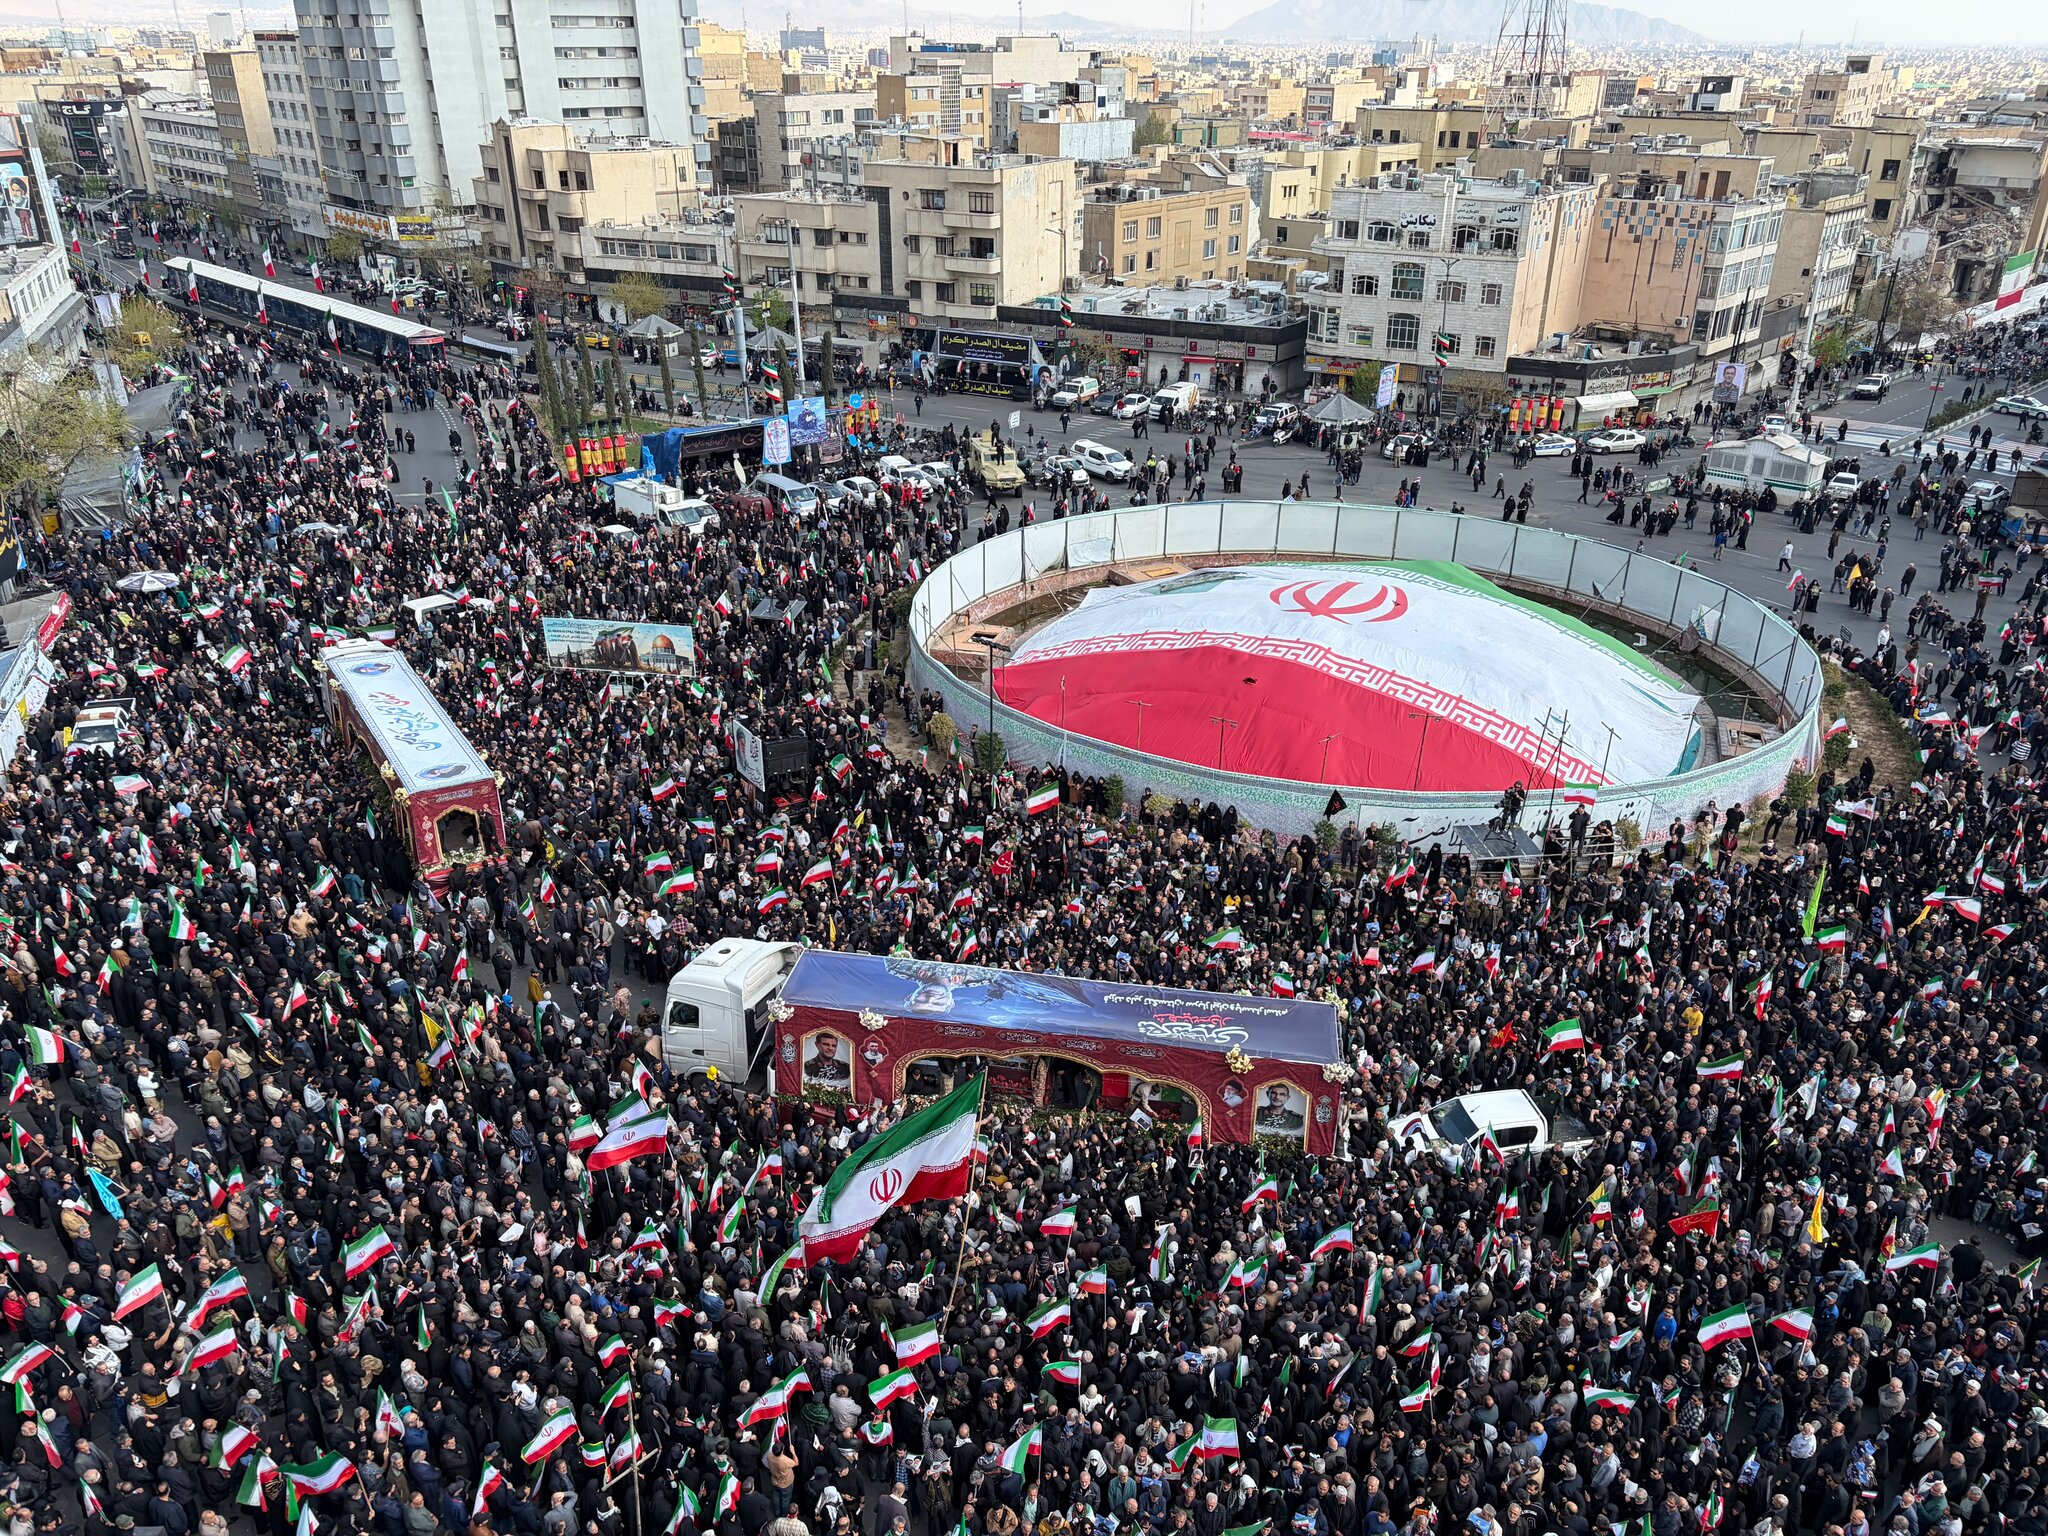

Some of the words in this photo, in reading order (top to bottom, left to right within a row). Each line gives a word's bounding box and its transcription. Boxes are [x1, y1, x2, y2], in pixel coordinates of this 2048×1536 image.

[62, 105, 91, 115] گاج
[970, 337, 992, 347] الصدر
[1103, 995, 1125, 1004] فرزند
[1125, 996, 1142, 1005] دلیر
[1185, 1000, 1209, 1011] سرباز
[1209, 1002, 1230, 1012] ایران
[1263, 1006, 1289, 1017] اسلام
